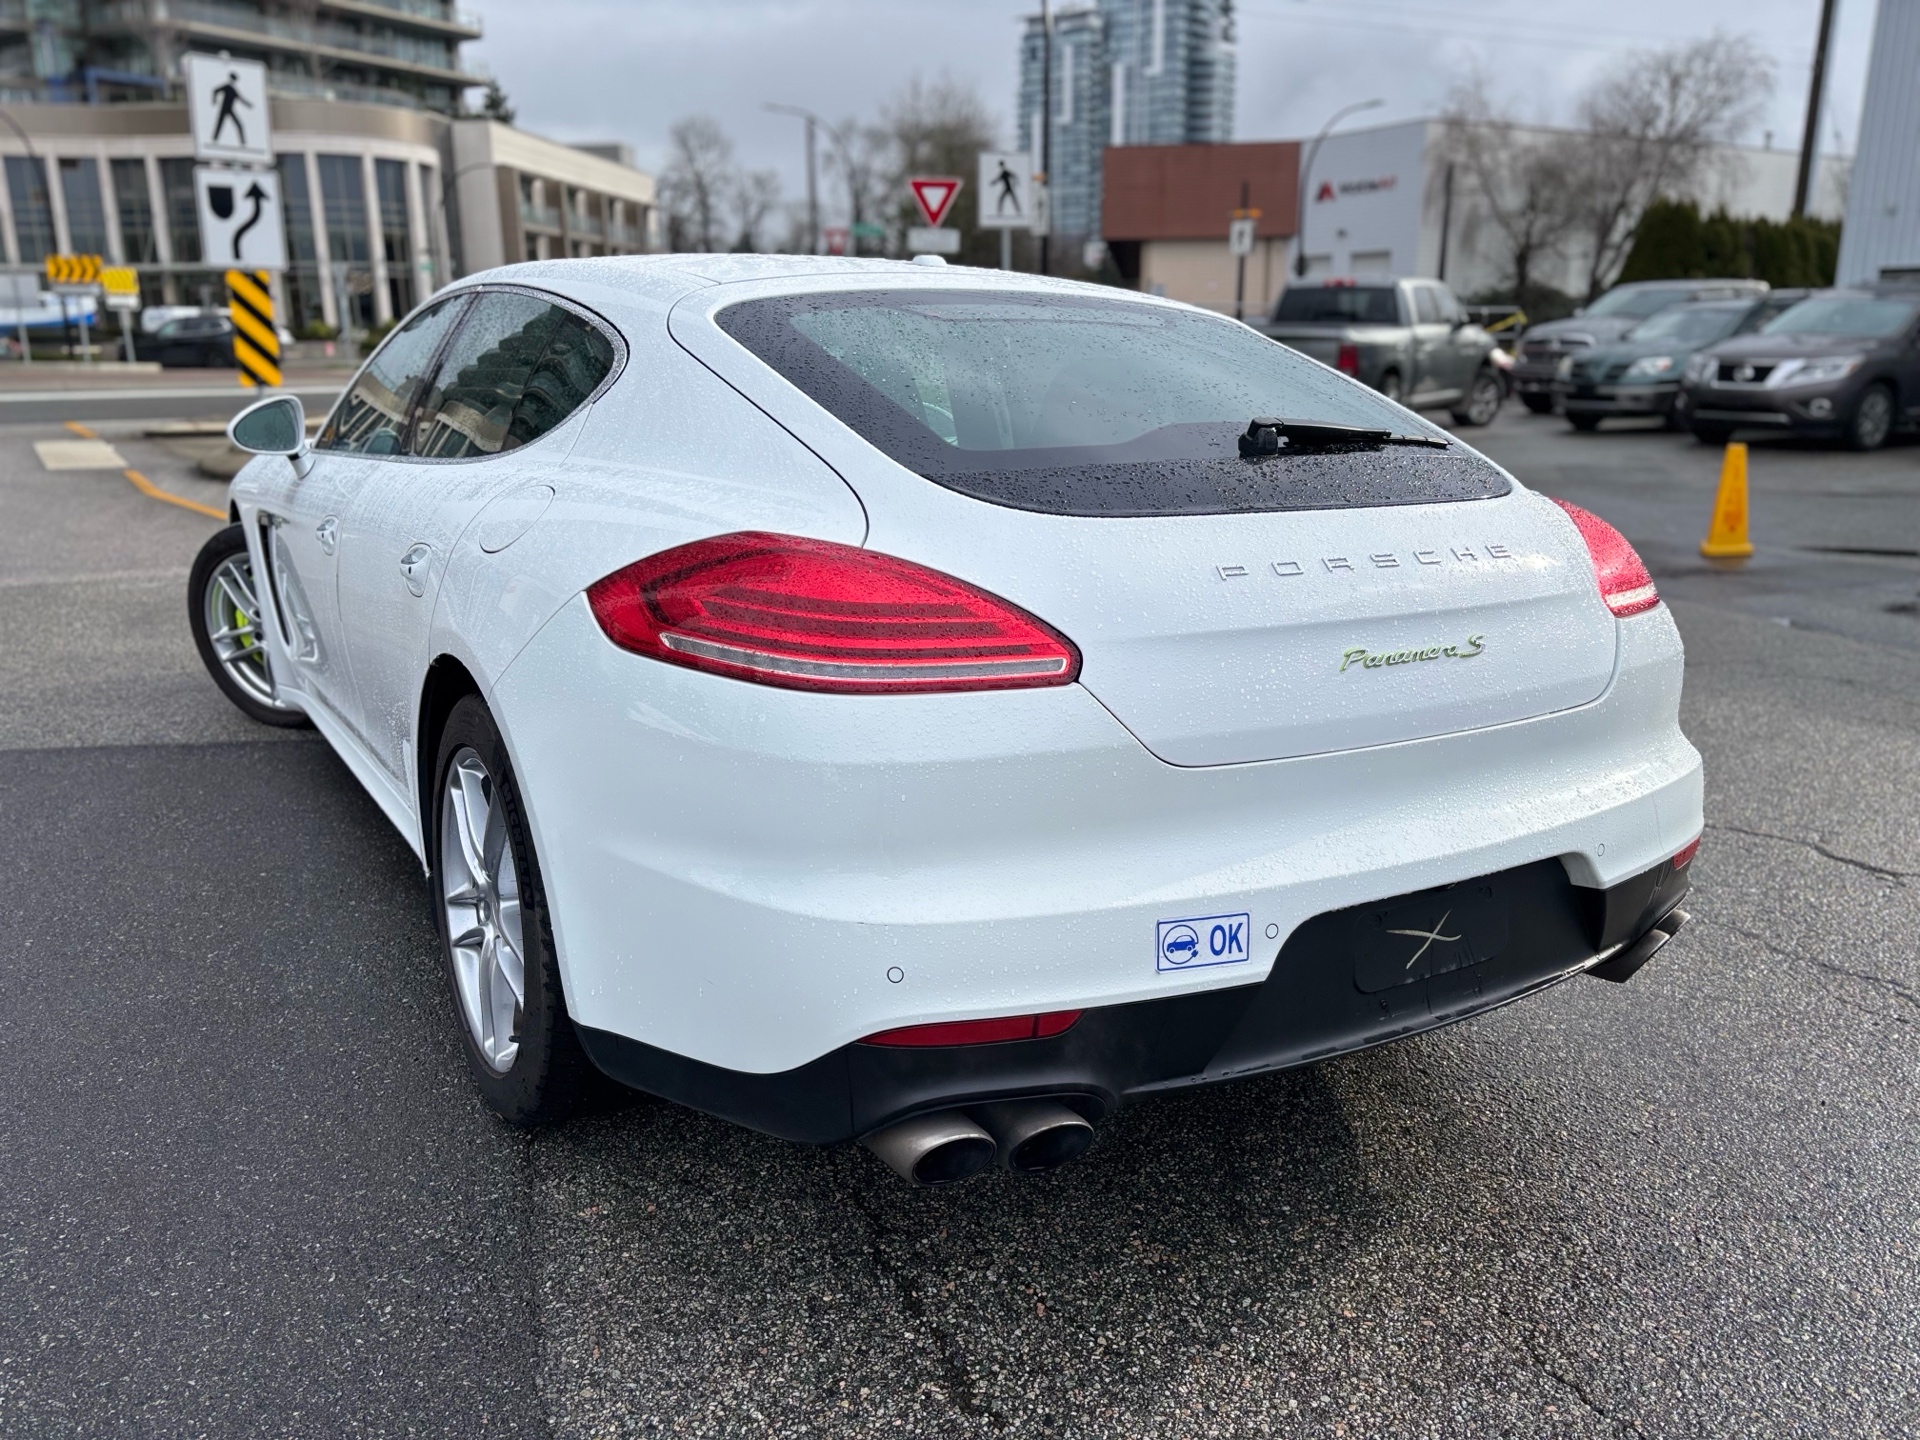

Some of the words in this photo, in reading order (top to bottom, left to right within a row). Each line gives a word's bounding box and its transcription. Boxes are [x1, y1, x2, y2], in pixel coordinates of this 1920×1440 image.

[1216, 544, 1511, 580] PORSCHE
[1458, 633, 1486, 658] S
[1209, 922, 1244, 957] OK
